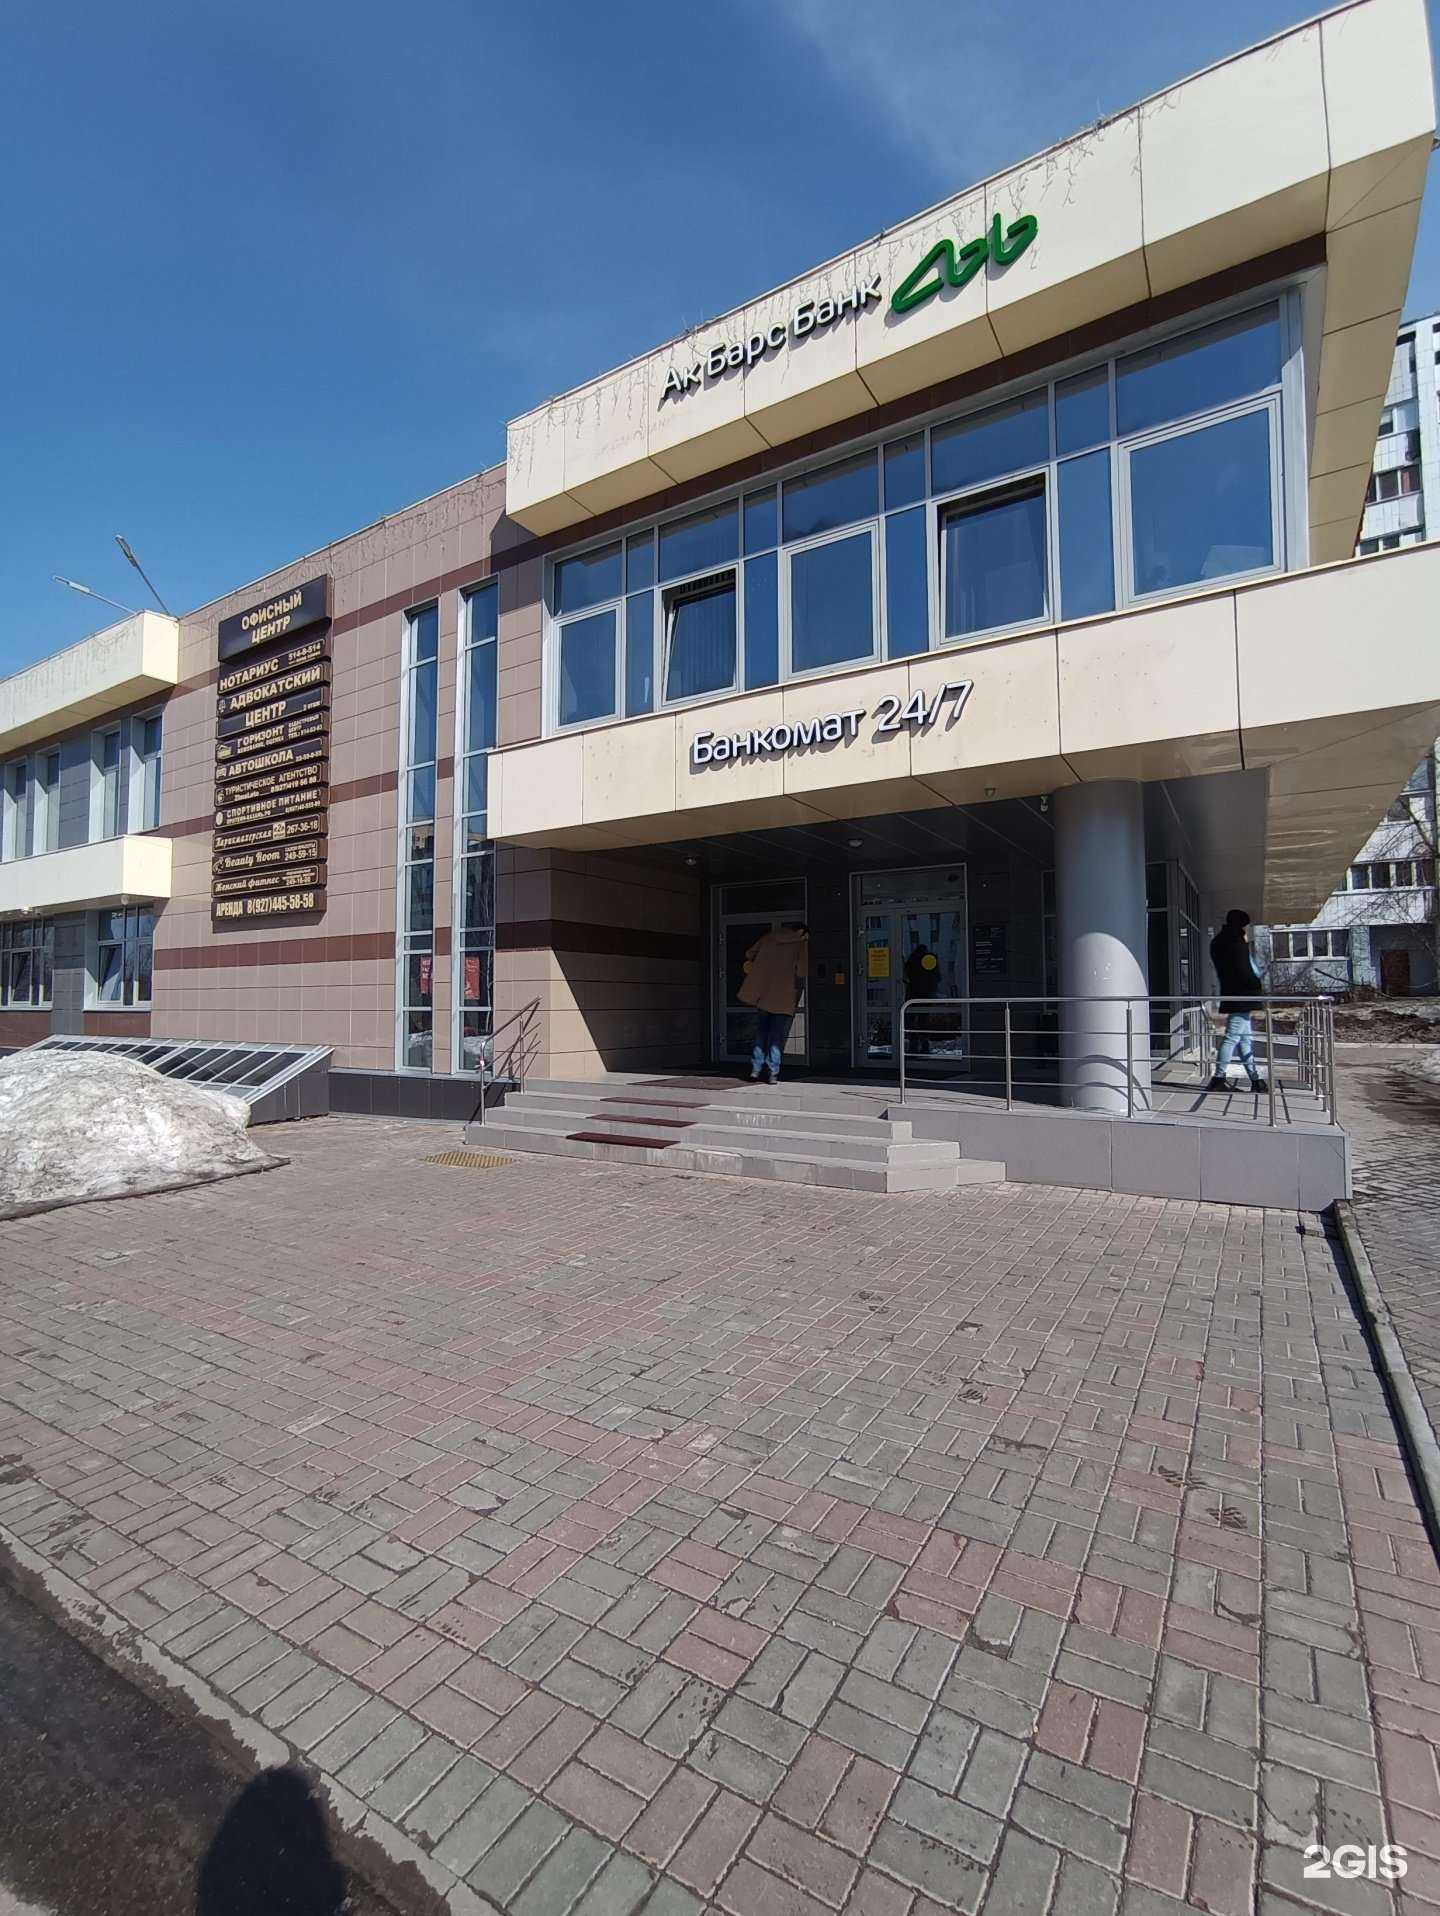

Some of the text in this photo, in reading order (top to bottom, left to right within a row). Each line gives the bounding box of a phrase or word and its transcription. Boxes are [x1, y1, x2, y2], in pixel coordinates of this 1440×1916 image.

[660, 274, 882, 402] Ак Барс Банк
[241, 590, 303, 631] ОФИСНЫЙ
[251, 615, 291, 643] ЦЕНТР
[219, 658, 279, 690] НОТАРИУС
[229, 665, 321, 710] АДВОКАТСКИЙ
[245, 700, 287, 728] ЦЕНТР
[692, 679, 974, 765] Банкомат 24/7
[237, 724, 285, 748] ГОРИЗОНТ
[228, 749, 294, 777] АВТОШКОЛА
[225, 765, 318, 796] ТУРИСТИЧЕСКОЕ АГЕНТСТВО
[226, 799, 277, 818] СПОРТИВНОЕ
[278, 791, 318, 806] ПИТАНИЕ
[215, 829, 273, 849] Парикмахерская
[224, 850, 281, 868] Beauty Room
[215, 876, 280, 892] Женский фитнес
[215, 892, 315, 918] АРЕНДА 8(927)445-58-58
